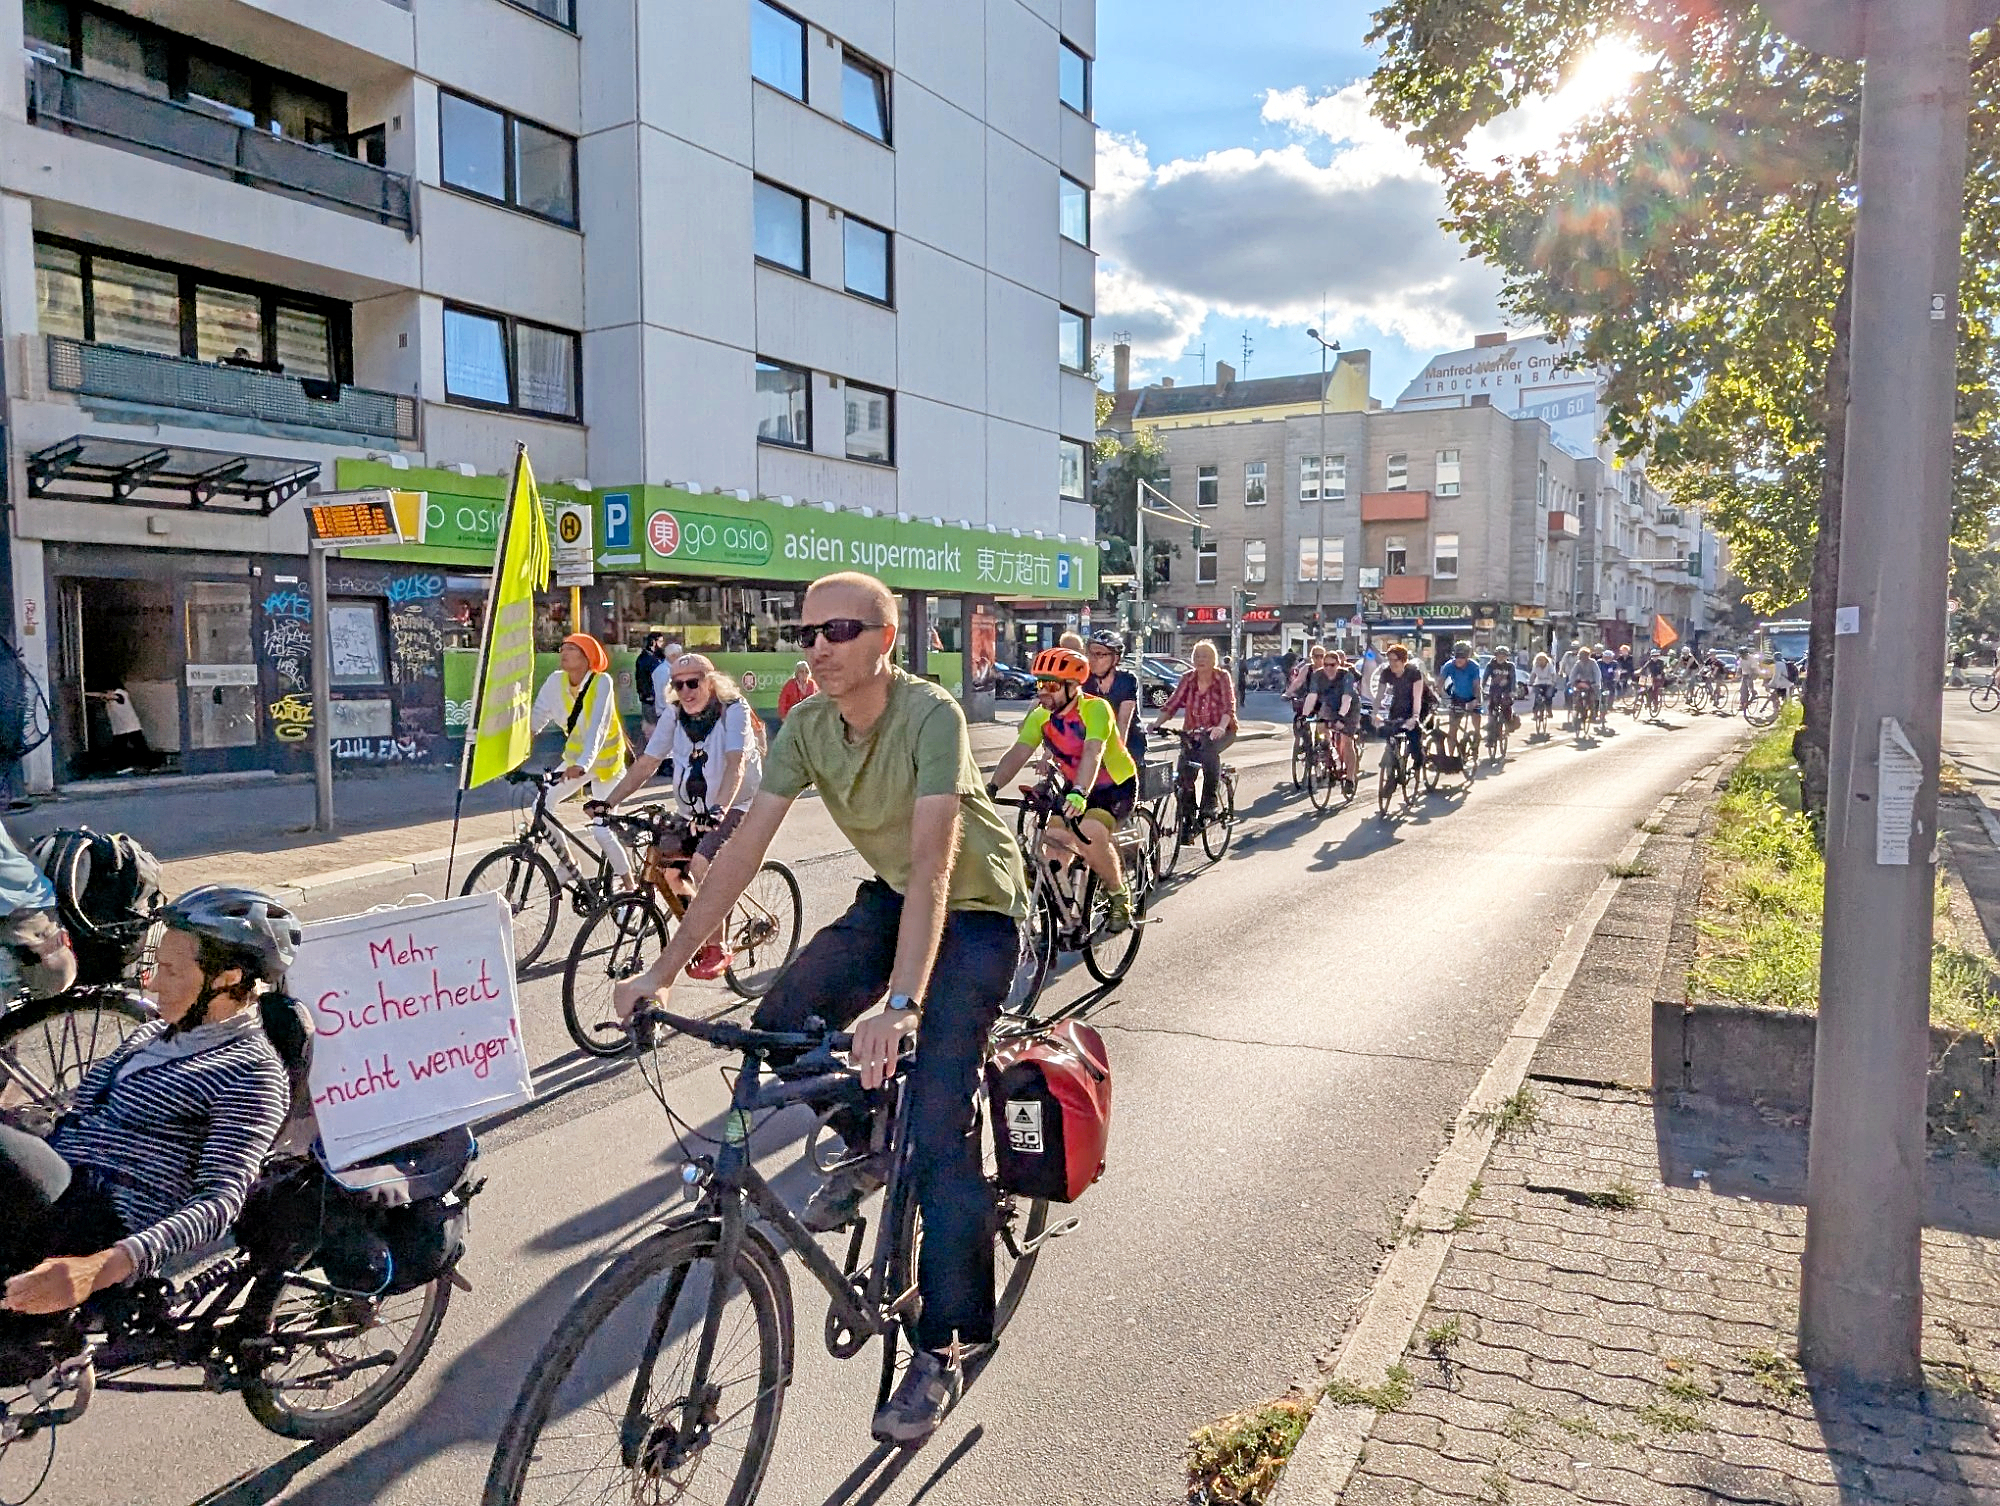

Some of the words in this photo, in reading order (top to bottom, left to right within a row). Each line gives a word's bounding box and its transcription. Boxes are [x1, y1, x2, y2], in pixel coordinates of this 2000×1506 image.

[1425, 363, 1473, 379] Manfred
[1567, 398, 1584, 416] 60
[564, 518, 577, 536] H
[607, 502, 628, 539] P
[653, 520, 676, 549] 東
[684, 522, 717, 555] go
[723, 526, 768, 551] asia
[784, 528, 844, 563] asien
[850, 541, 962, 574] supermarkt
[976, 546, 1051, 586] 東方超市
[1058, 559, 1069, 584] P
[369, 933, 439, 969] Mehr
[314, 958, 500, 1036] Sicherheit
[407, 1018, 518, 1079] weniger!
